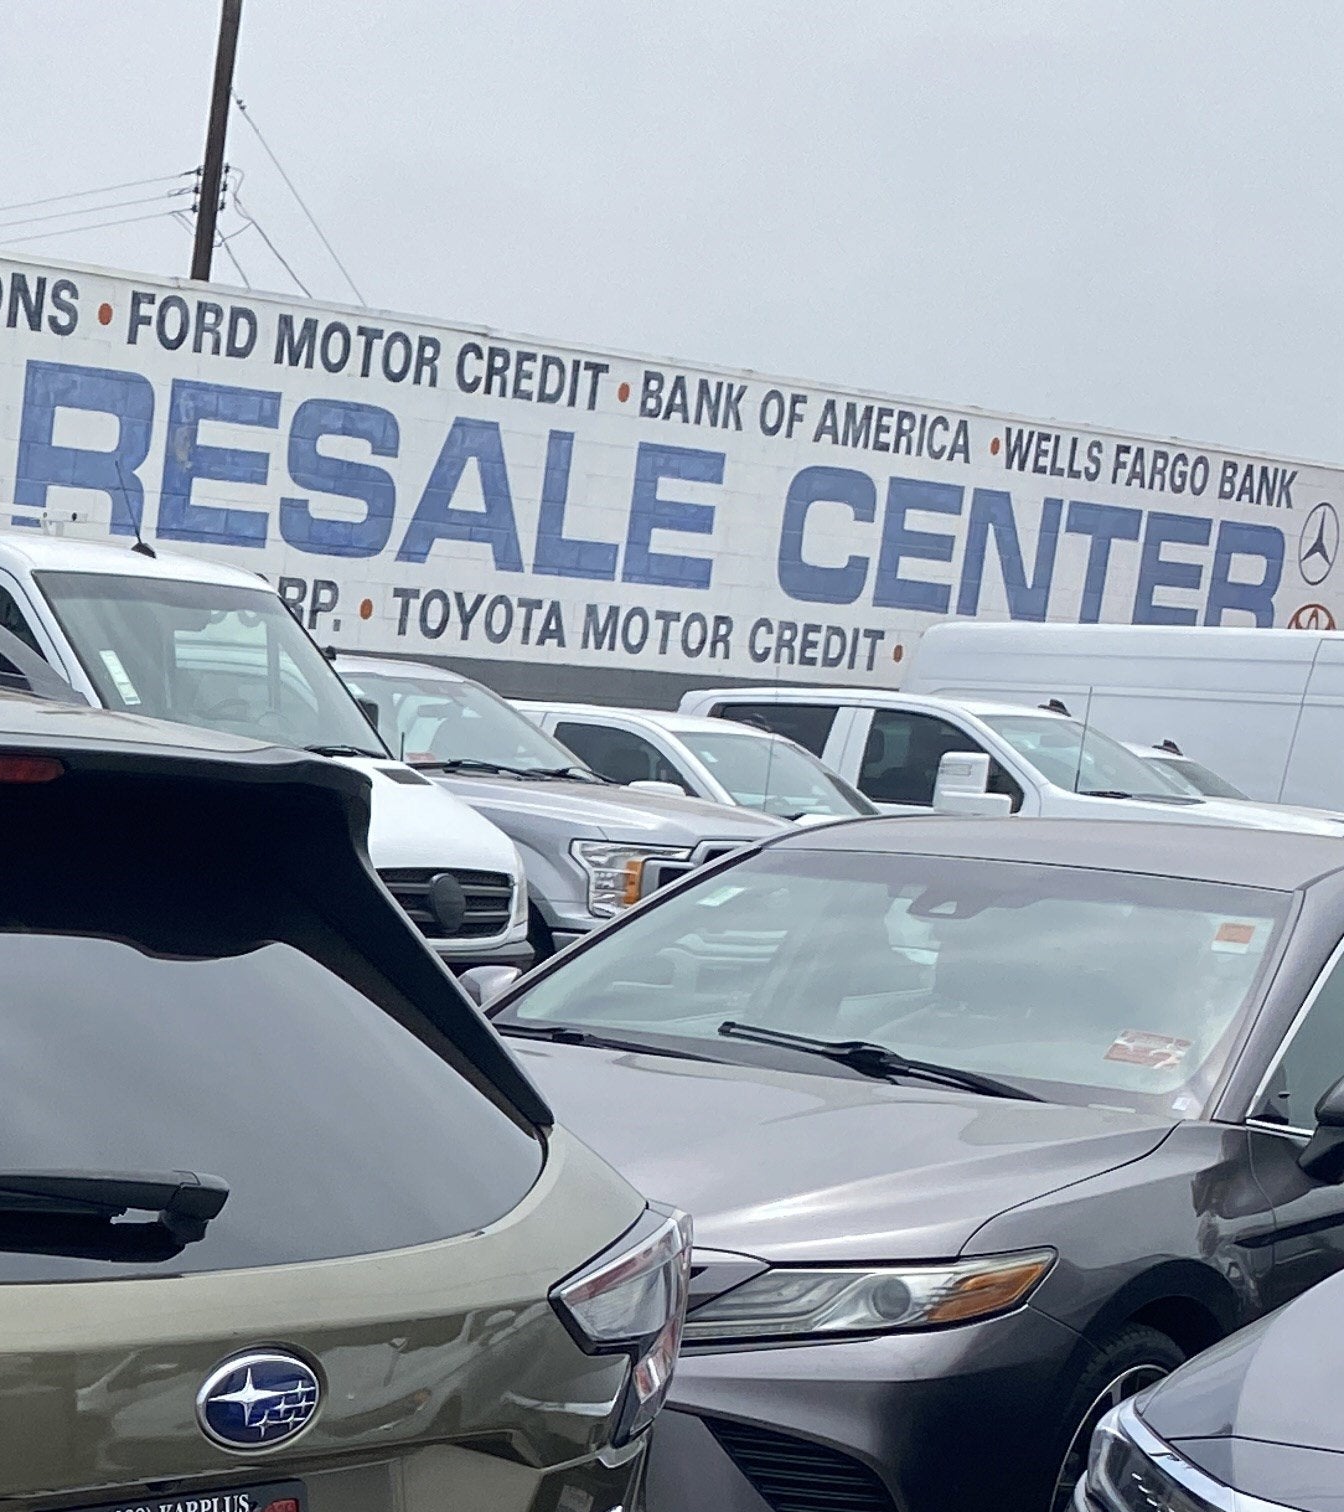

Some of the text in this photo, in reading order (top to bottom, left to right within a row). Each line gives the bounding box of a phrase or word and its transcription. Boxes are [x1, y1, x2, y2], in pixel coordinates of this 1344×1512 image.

[12, 360, 726, 590] RESALE
[778, 465, 1286, 629] CENTER
[127, 289, 257, 359] FORD
[274, 313, 440, 387] MOTOR
[456, 342, 609, 411] CREDIT
[639, 370, 748, 431] BANK
[759, 388, 808, 439] OF
[812, 399, 971, 464] AMERICA
[1005, 426, 1103, 482] WELLS
[1111, 443, 1210, 497] FARGO
[1218, 460, 1298, 509] BANK
[393, 587, 566, 648] TOYOTA
[581, 604, 733, 660] MOTOR
[749, 617, 885, 672] CREDIT
